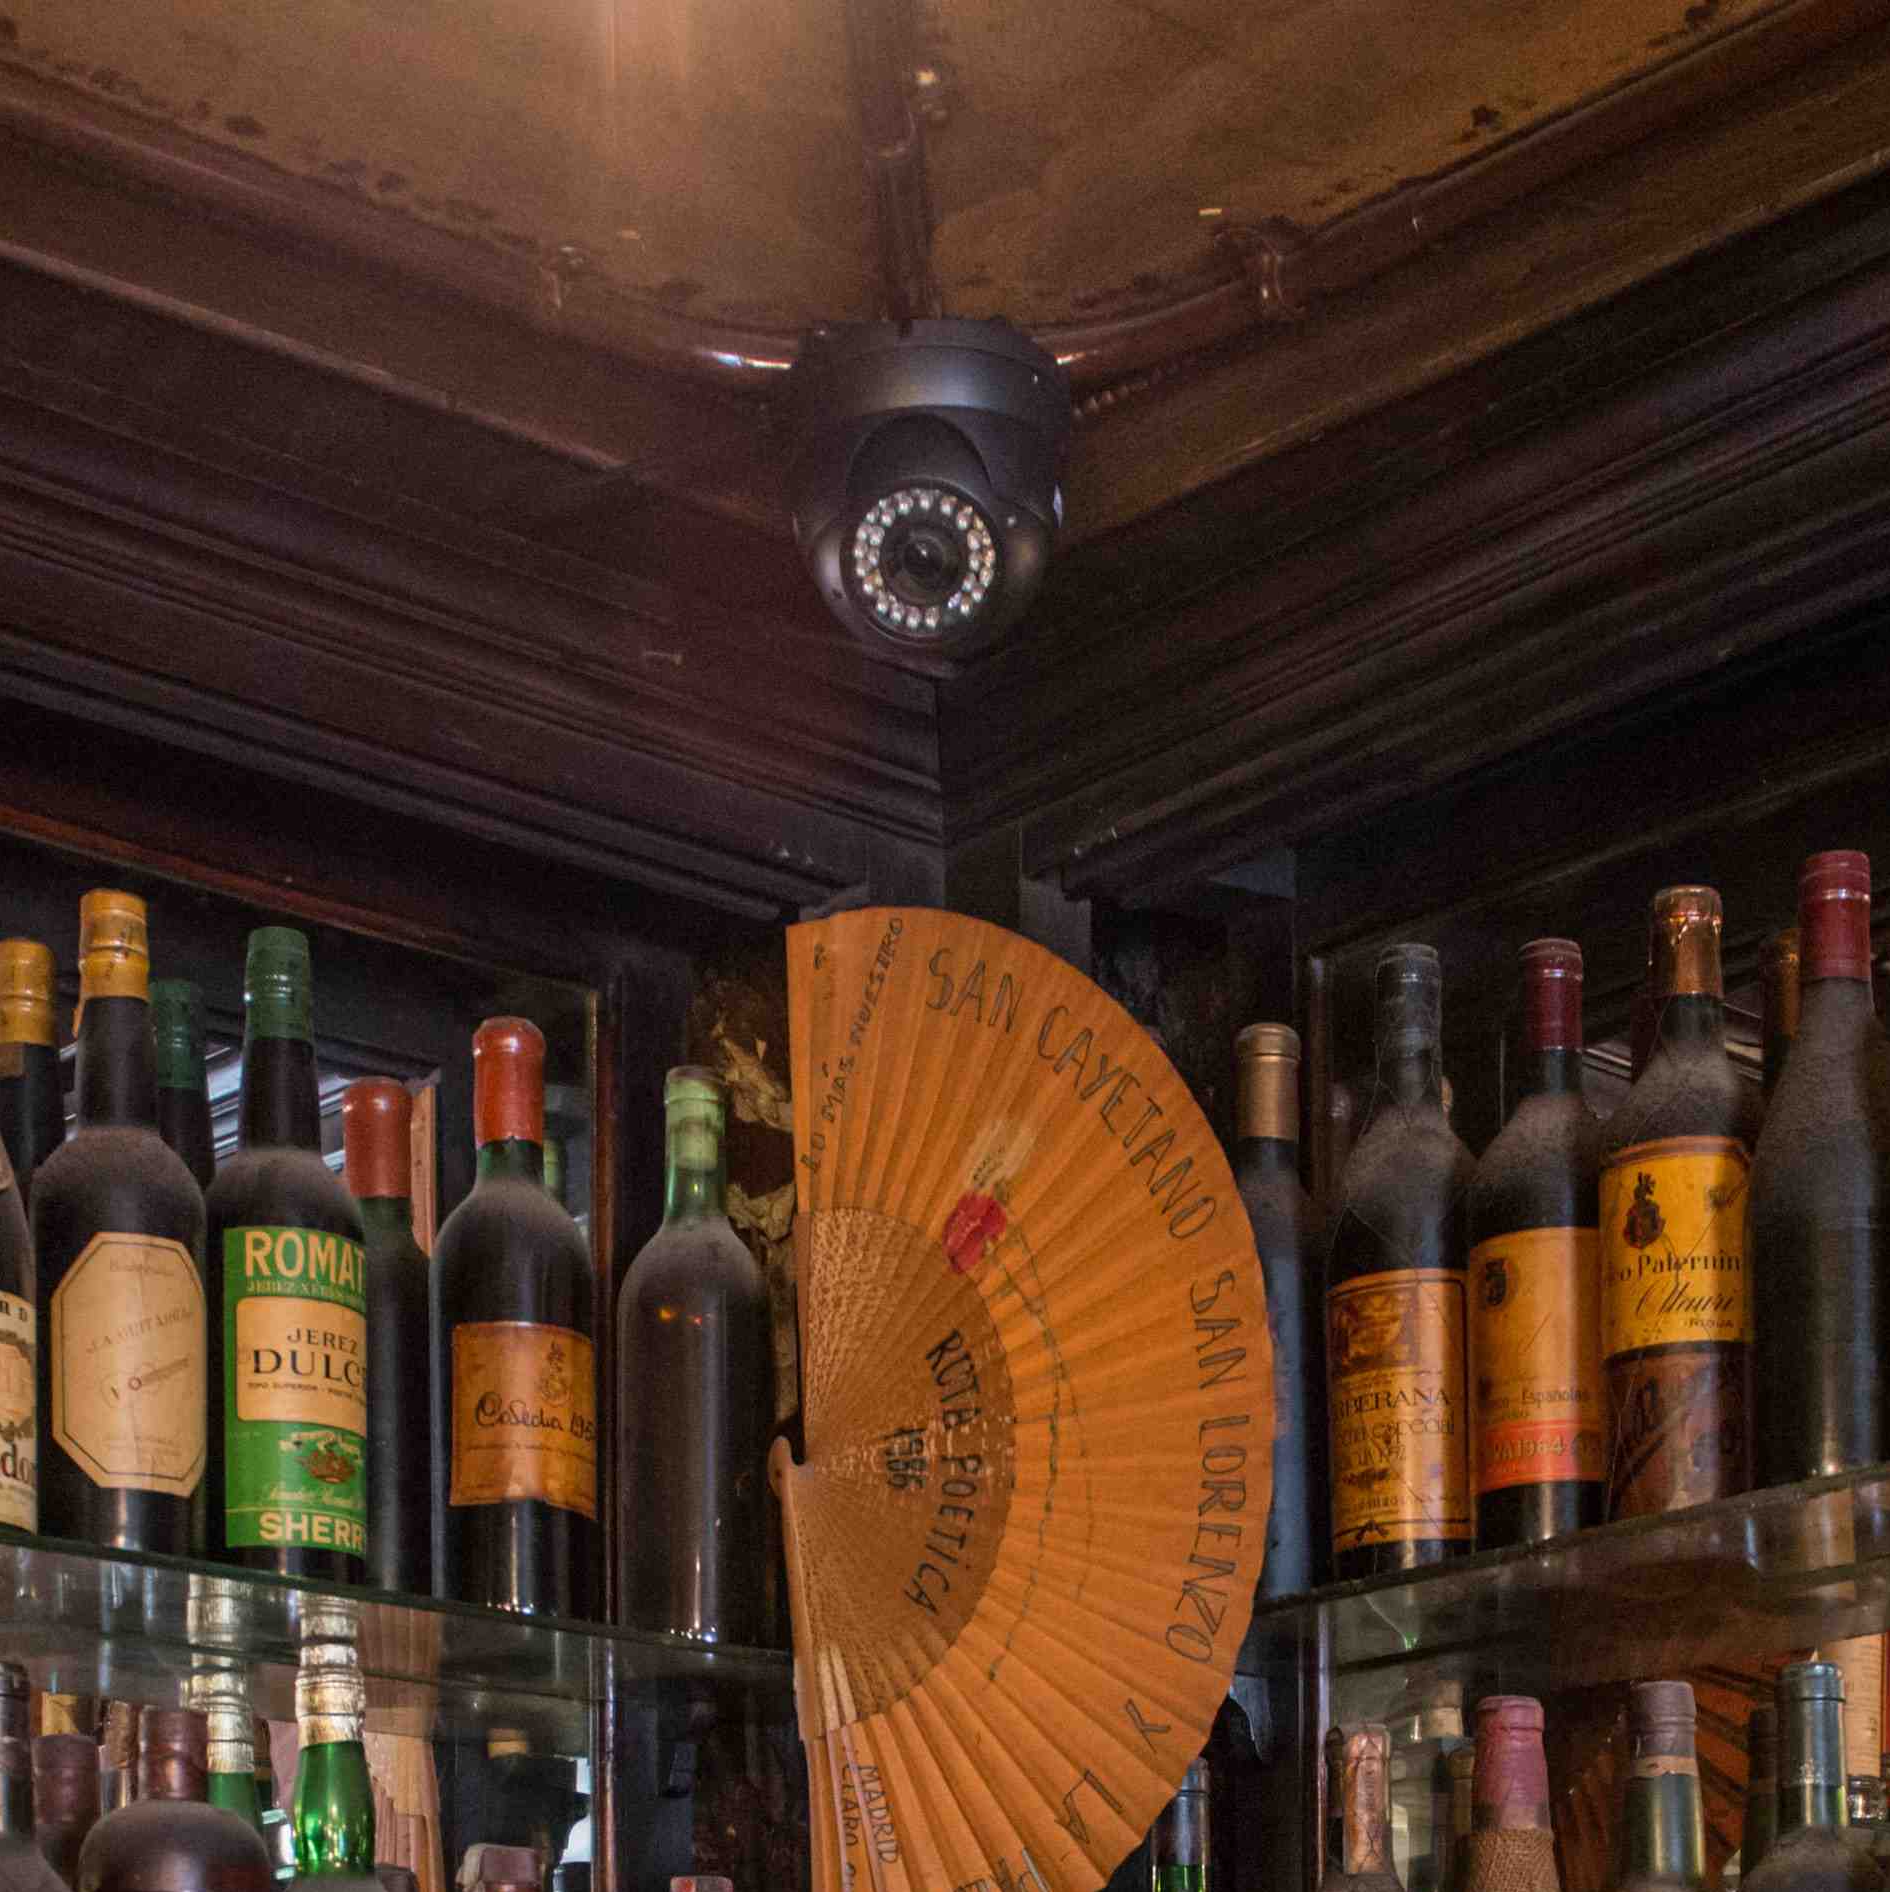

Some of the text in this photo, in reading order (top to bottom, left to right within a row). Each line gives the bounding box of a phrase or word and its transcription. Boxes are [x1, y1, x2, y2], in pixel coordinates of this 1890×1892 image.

[926, 948, 1025, 1034] SAN
[1037, 1004, 1217, 1242] CAYETANO
[252, 1348, 366, 1391] DULC
[286, 1327, 360, 1355] JEREZ
[1189, 1269, 1250, 1391] SAN
[903, 1454, 983, 1616] POETICA
[1165, 1414, 1250, 1665] LORENZO
[1124, 1697, 1173, 1754] Y
[858, 1764, 900, 1865] MADRID
